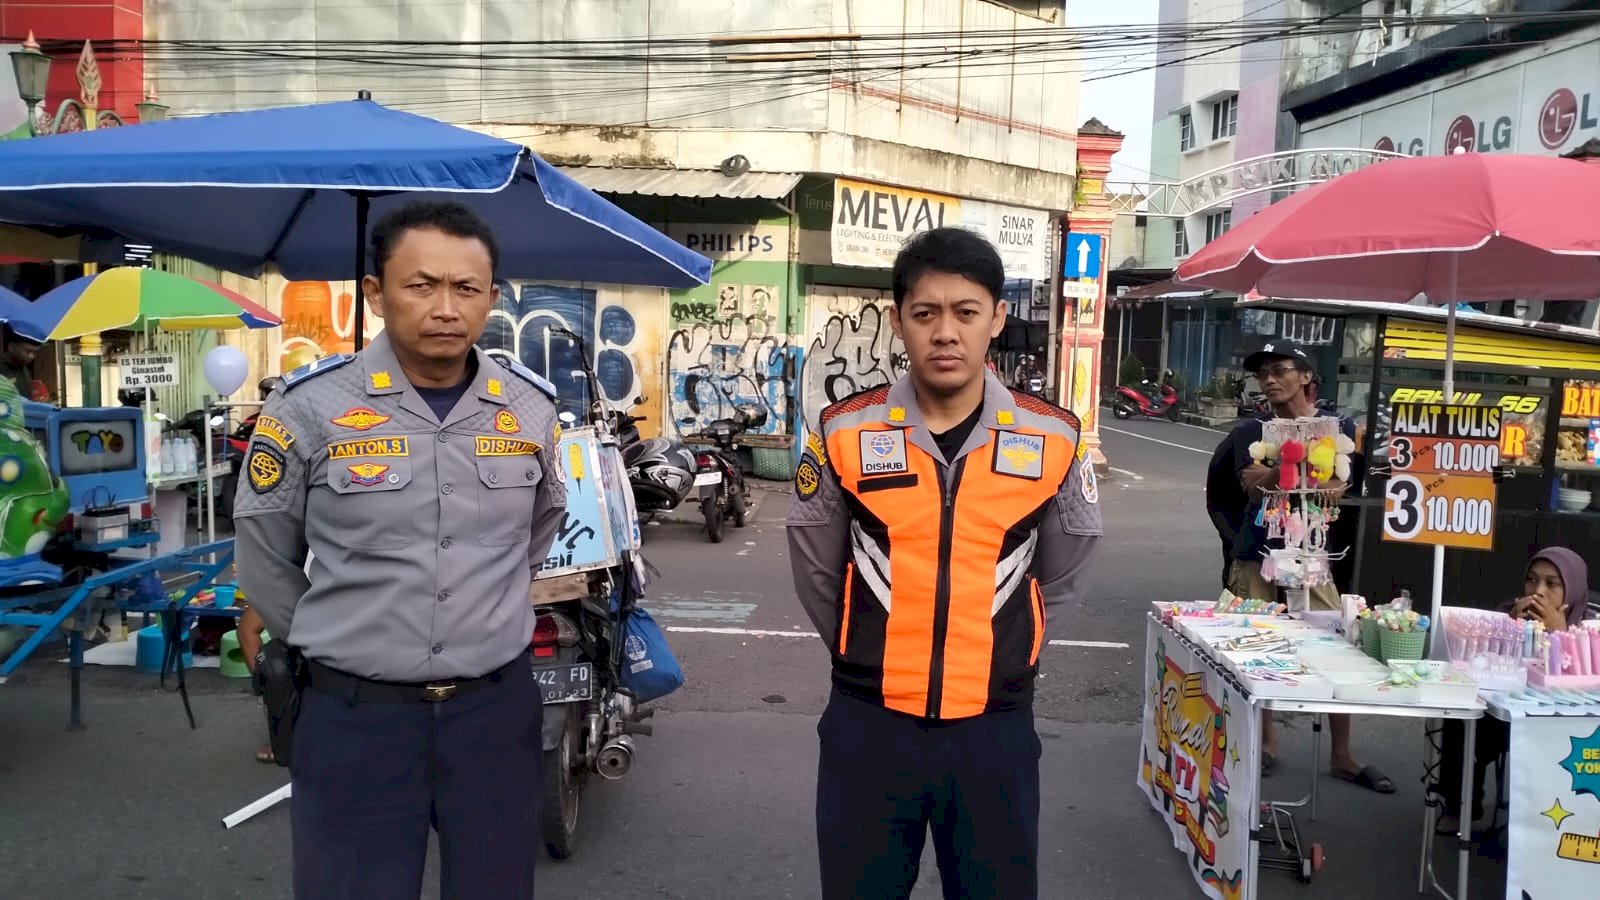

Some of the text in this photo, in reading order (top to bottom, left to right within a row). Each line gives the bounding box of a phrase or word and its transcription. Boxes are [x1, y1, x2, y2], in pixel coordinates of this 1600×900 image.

[1477, 116, 1512, 153] LG
[1002, 215, 1035, 231] SINAR
[836, 228, 870, 240] LIGHTING
[998, 230, 1034, 246] MULYA
[686, 233, 774, 252] PHILIPS
[121, 356, 173, 366] ES TEH JUMBO
[125, 374, 173, 386] Rp. 3000
[1497, 395, 1541, 413] 66
[1394, 404, 1500, 438] ALAT TULIS
[335, 440, 401, 457] ANTON.S
[1002, 436, 1040, 451] DISHUB
[1389, 437, 1412, 470] 3
[1432, 441, 1499, 473] 10.000
[865, 462, 903, 471] DISHUB
[1384, 474, 1424, 539] 3
[1426, 496, 1492, 535] 10.000
[570, 666, 588, 682] FD
